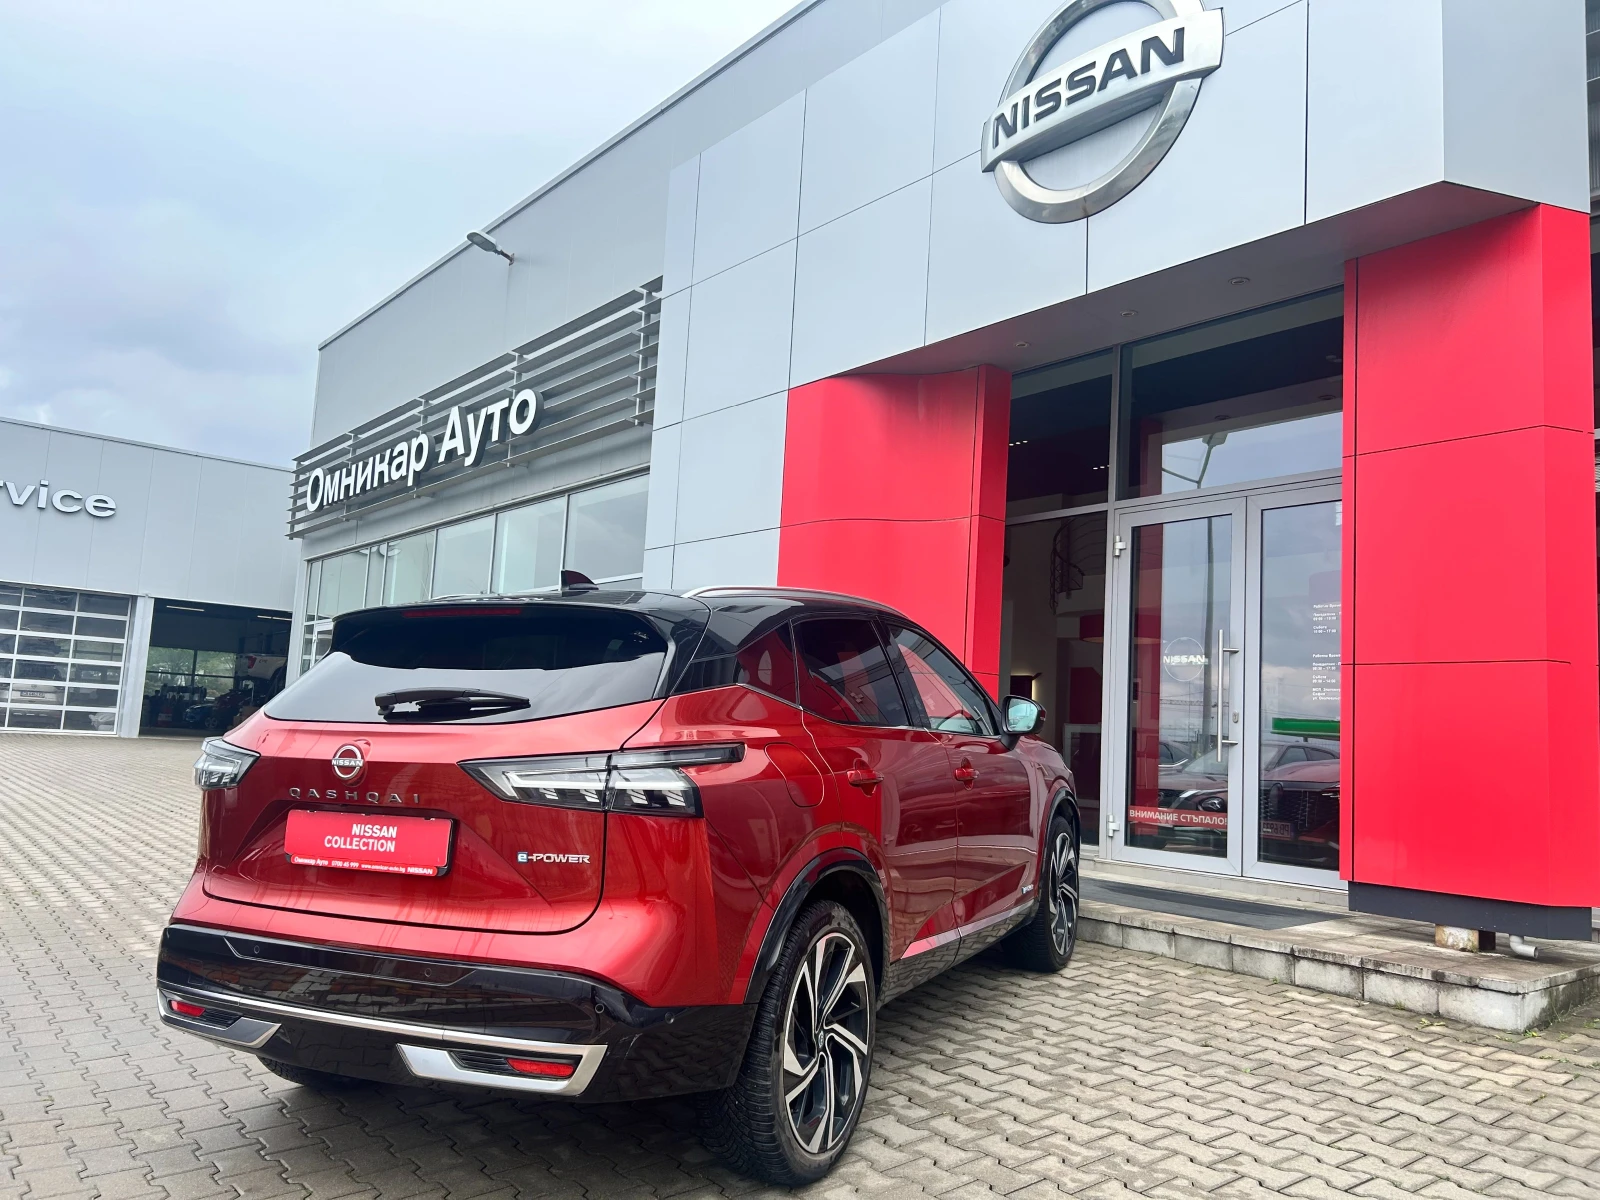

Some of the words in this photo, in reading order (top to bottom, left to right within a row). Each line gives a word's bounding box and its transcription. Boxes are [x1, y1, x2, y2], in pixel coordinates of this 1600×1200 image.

[992, 26, 1186, 149] NISSAN
[306, 433, 430, 513] Омникар
[438, 388, 538, 467] Ауто
[1163, 654, 1205, 664] NISSAN
[332, 758, 364, 766] NISSAN
[289, 787, 420, 804] QASHQAI
[1129, 809, 1179, 821] ВНИМАНИЕ
[352, 823, 397, 838] NISSAN
[324, 836, 396, 853] COLLECTION
[517, 851, 591, 864] e-POWER
[407, 866, 433, 875] NISSAN
